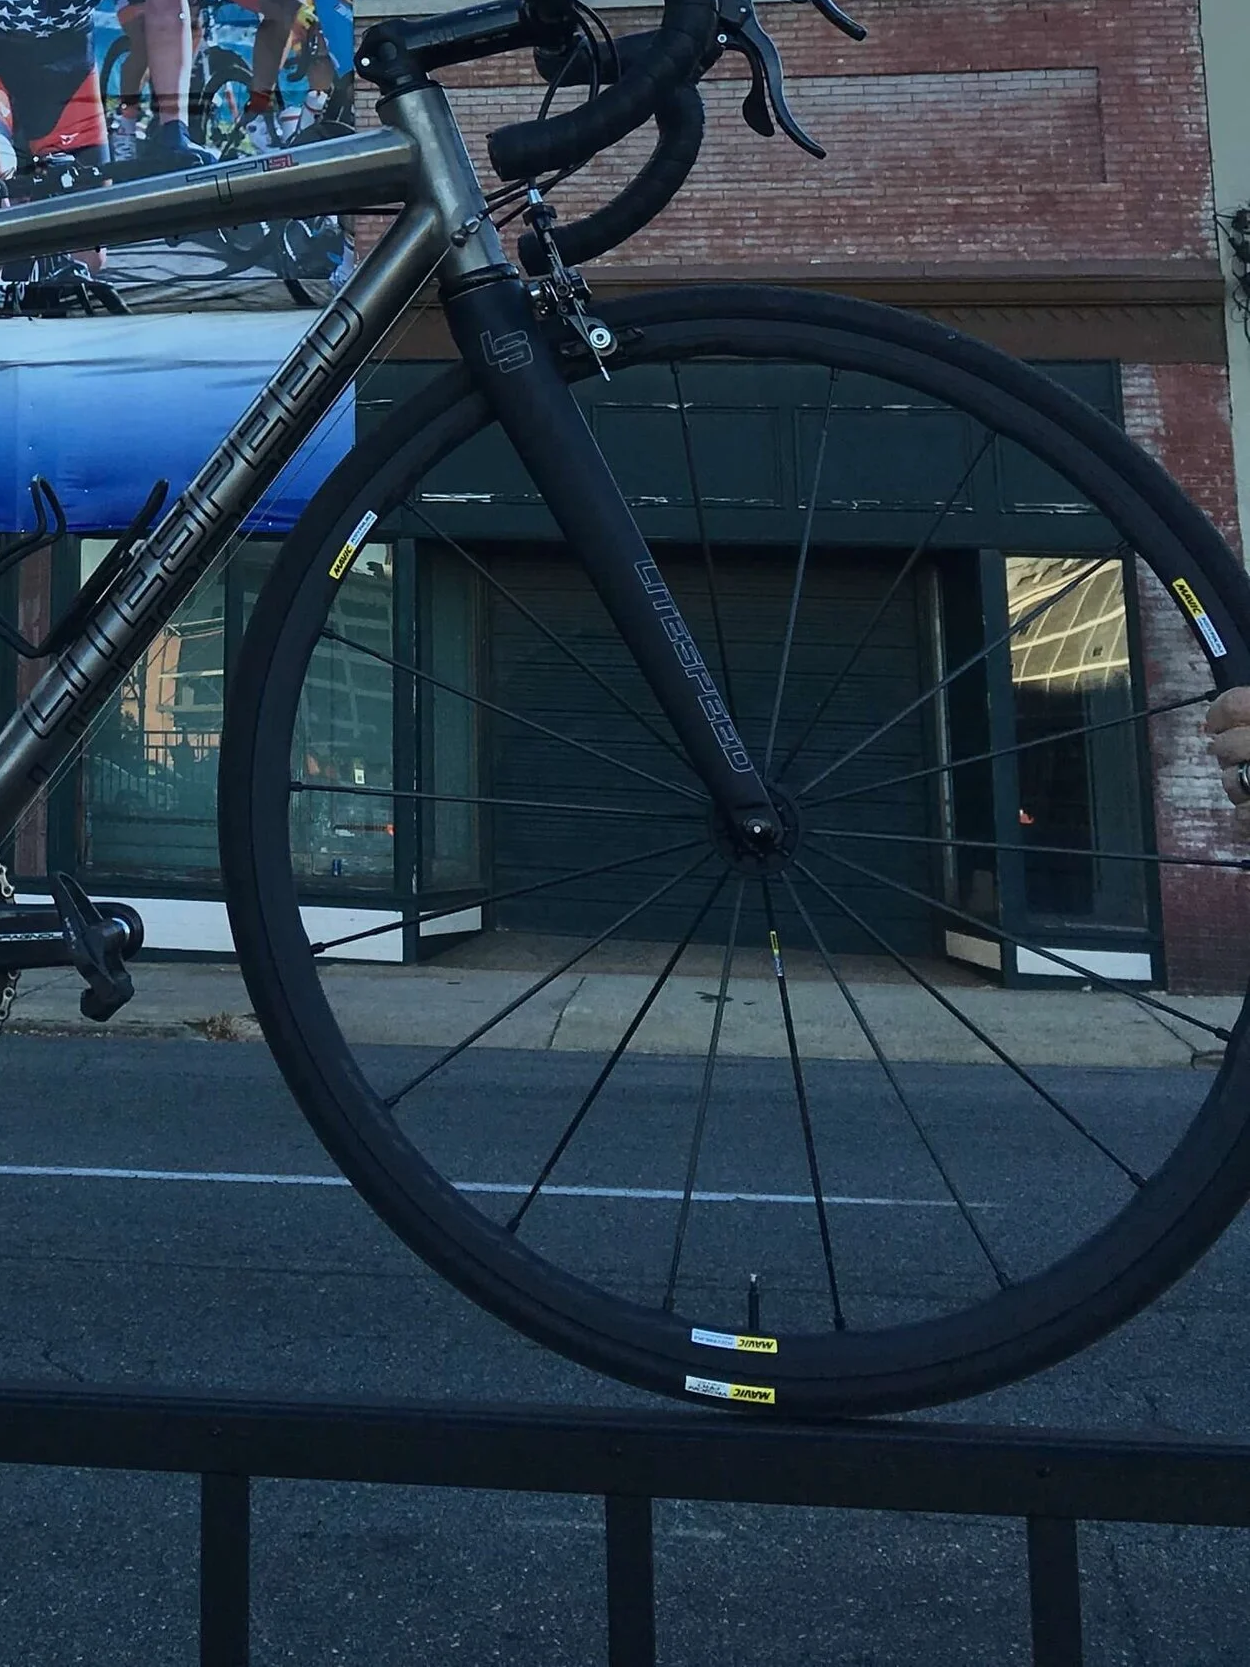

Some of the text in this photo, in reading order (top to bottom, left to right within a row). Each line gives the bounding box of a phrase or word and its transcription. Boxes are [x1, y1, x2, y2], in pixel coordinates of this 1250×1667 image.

[23, 296, 365, 739] LITESPEED
[333, 544, 353, 577] MAVIC
[1176, 583, 1203, 614] MAVIC
[634, 559, 754, 773] LITESPEED
[738, 1339, 774, 1349] MAVIC
[733, 1388, 771, 1400] MAVIC
